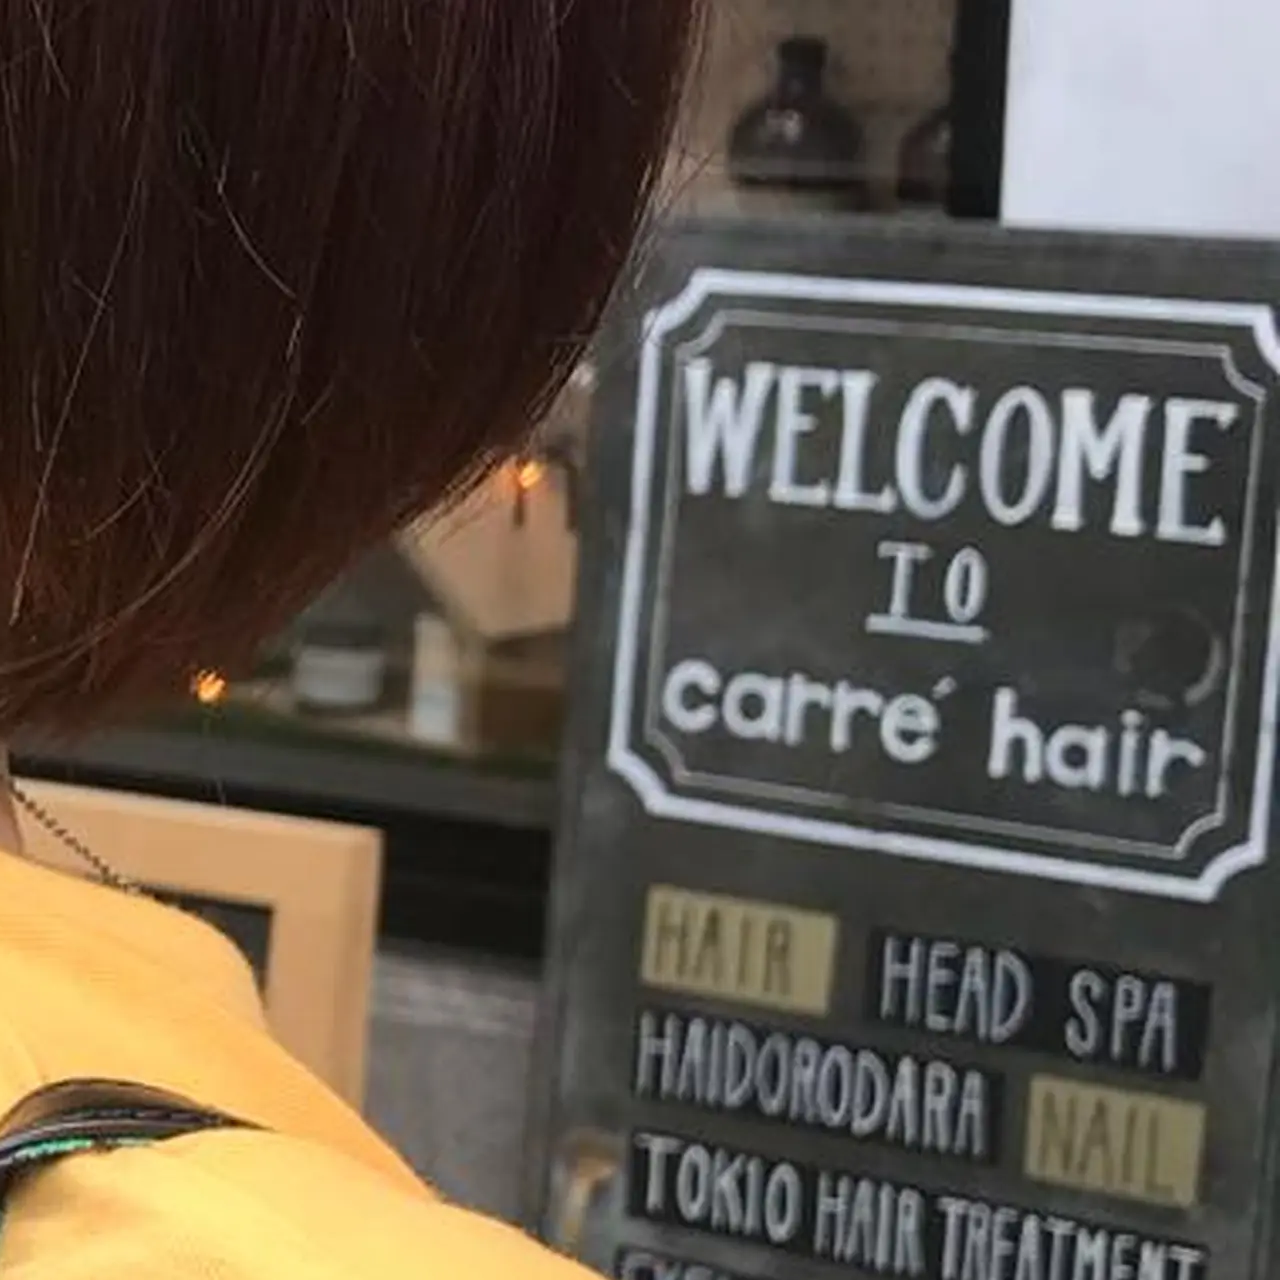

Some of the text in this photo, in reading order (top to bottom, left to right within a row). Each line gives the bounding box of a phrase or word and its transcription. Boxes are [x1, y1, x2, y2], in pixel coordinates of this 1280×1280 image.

[683, 357, 1238, 546] WELCOME
[876, 540, 989, 622] TO
[661, 657, 1207, 798] carré hair
[654, 900, 1178, 1073] HAIR HEAD SPA
[634, 1131, 803, 1243] TOKIO
[813, 1172, 927, 1278] HAIR
[1036, 1100, 1178, 1196] NAIL
